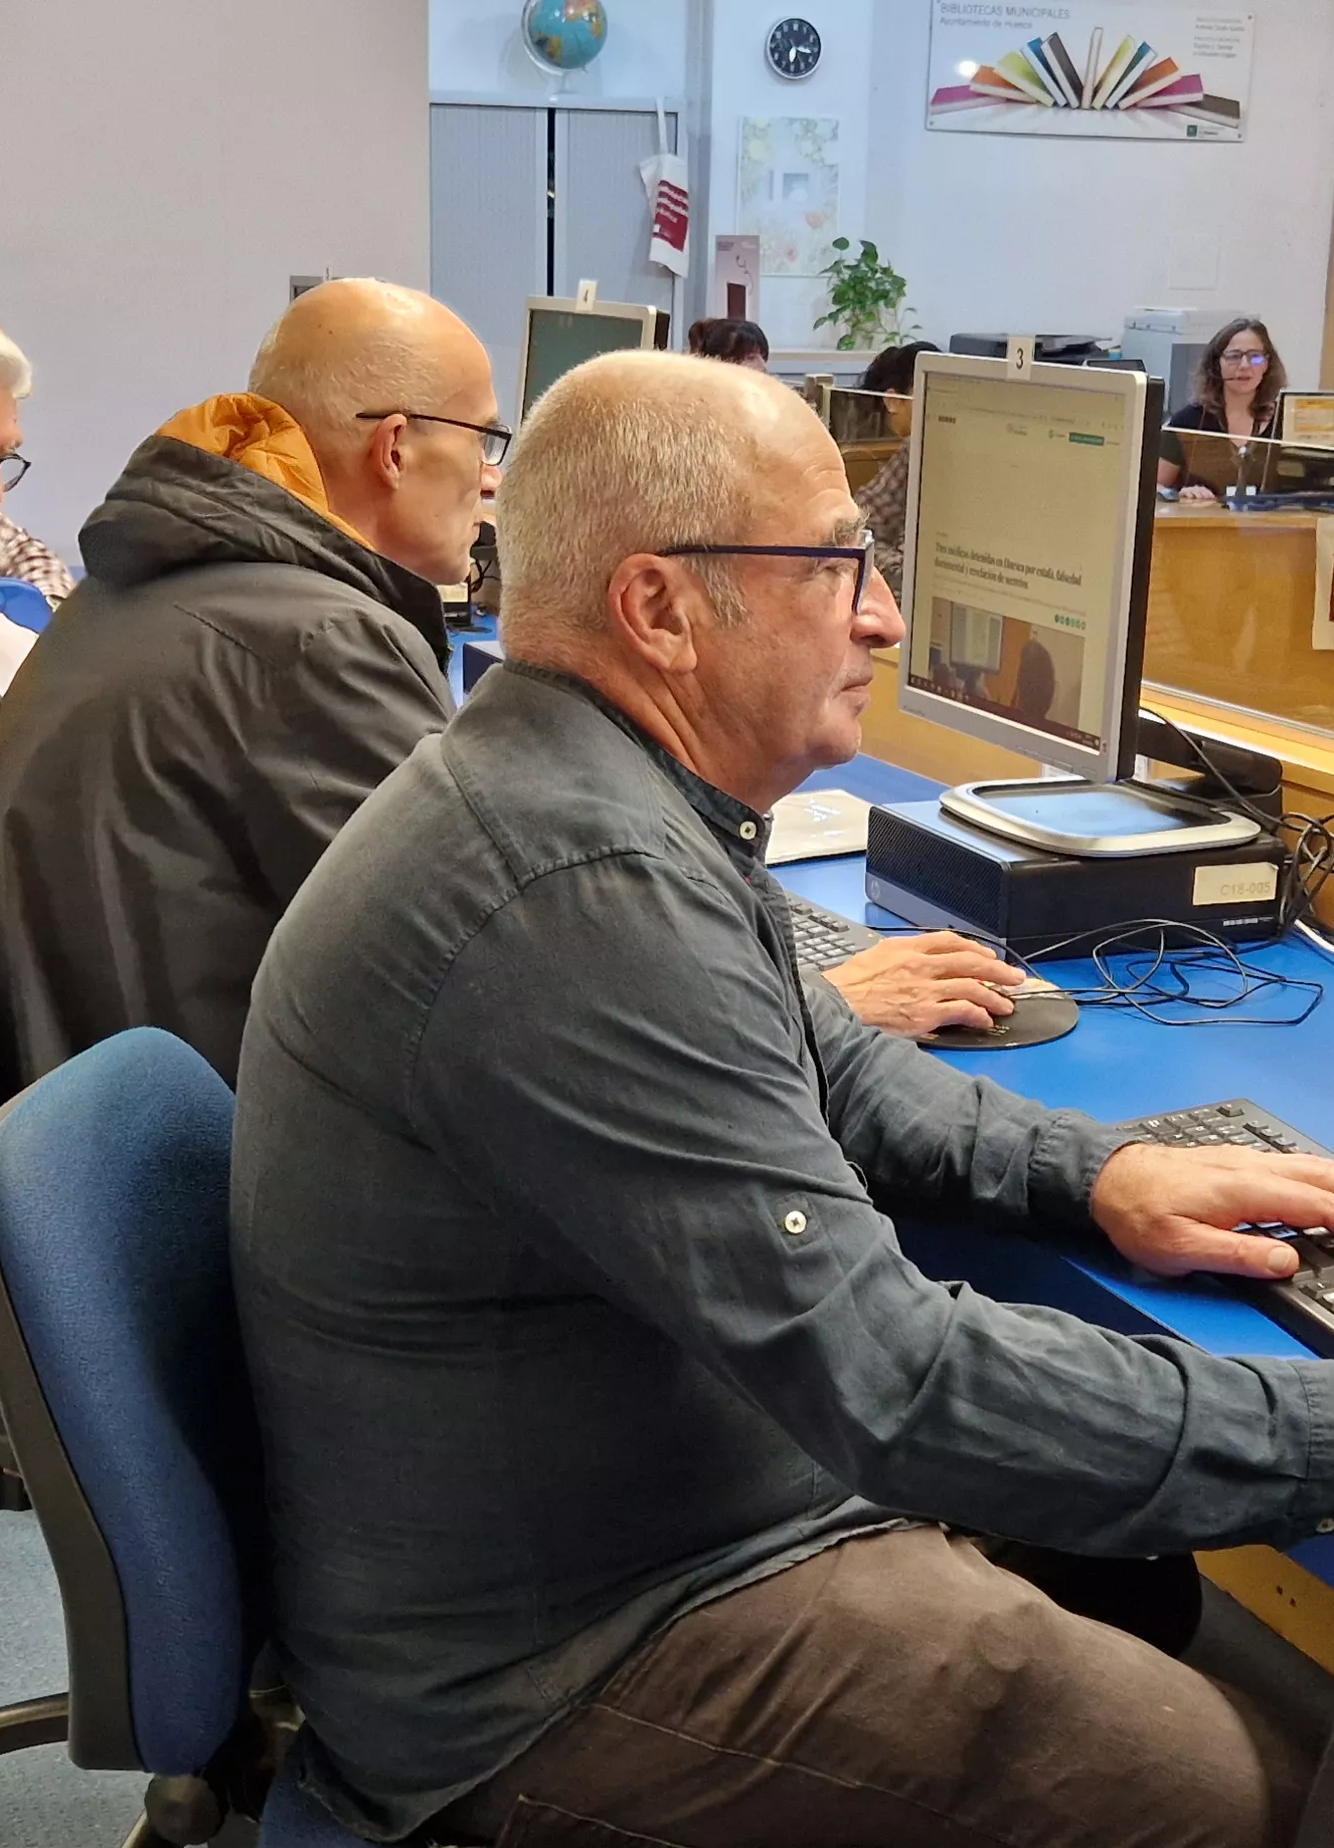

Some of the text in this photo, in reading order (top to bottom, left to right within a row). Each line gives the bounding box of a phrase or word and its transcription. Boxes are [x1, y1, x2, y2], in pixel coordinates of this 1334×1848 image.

[940, 3, 1071, 20] BIBLIOTECAS MUNICIPALES
[1015, 347, 1024, 370] 3
[1220, 881, 1271, 896] C18-005
